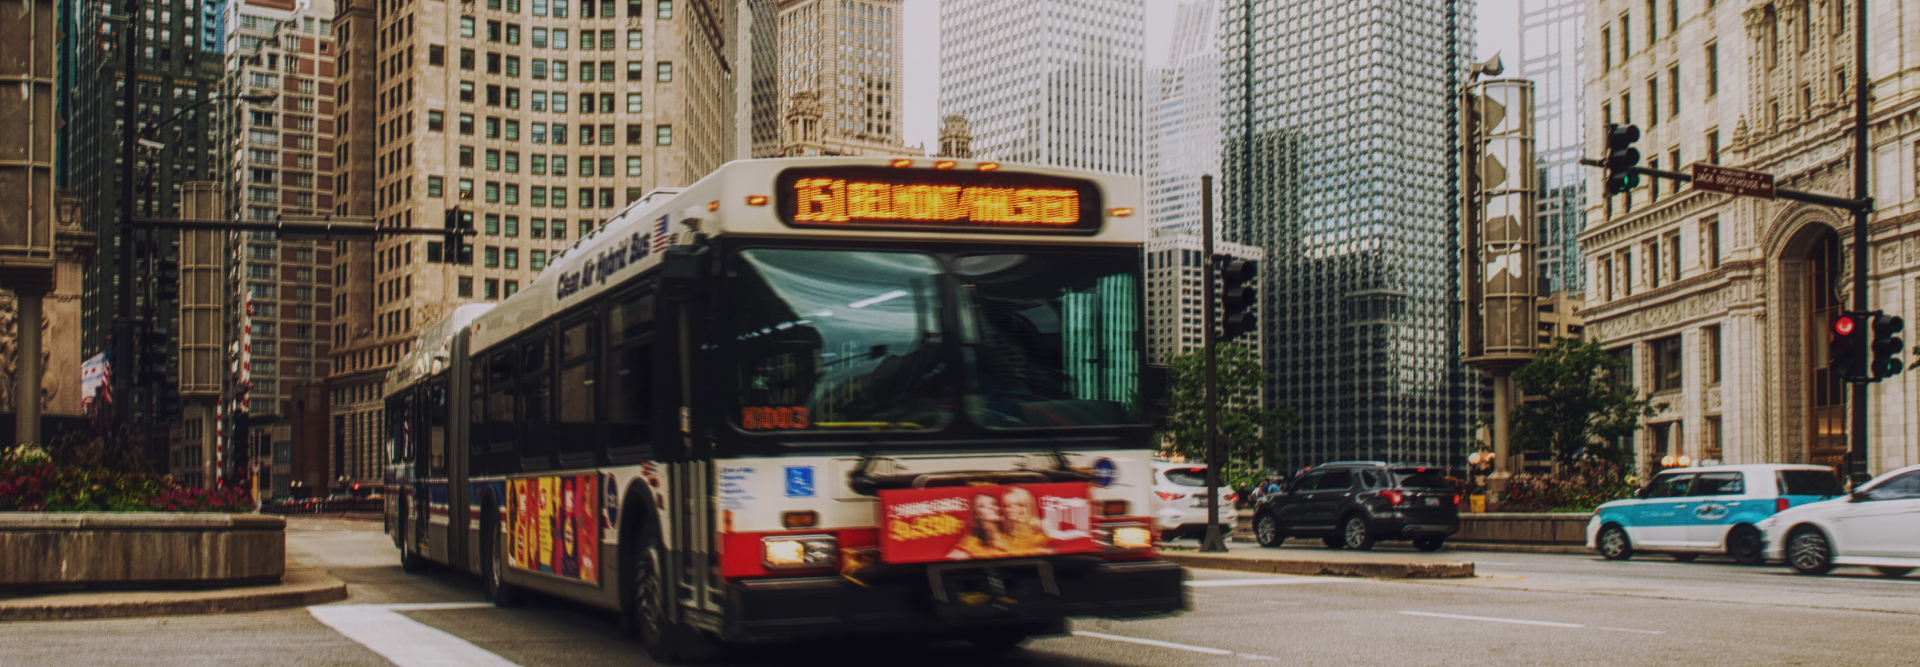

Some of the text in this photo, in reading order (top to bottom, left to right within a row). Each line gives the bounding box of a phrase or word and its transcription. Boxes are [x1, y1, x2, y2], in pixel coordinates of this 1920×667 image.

[794, 178, 847, 221] 151
[1696, 173, 1715, 183] JACK
[1716, 175, 1759, 190] BRICKHOUSE
[557, 232, 651, 301] Clean Air Hybrid Bus
